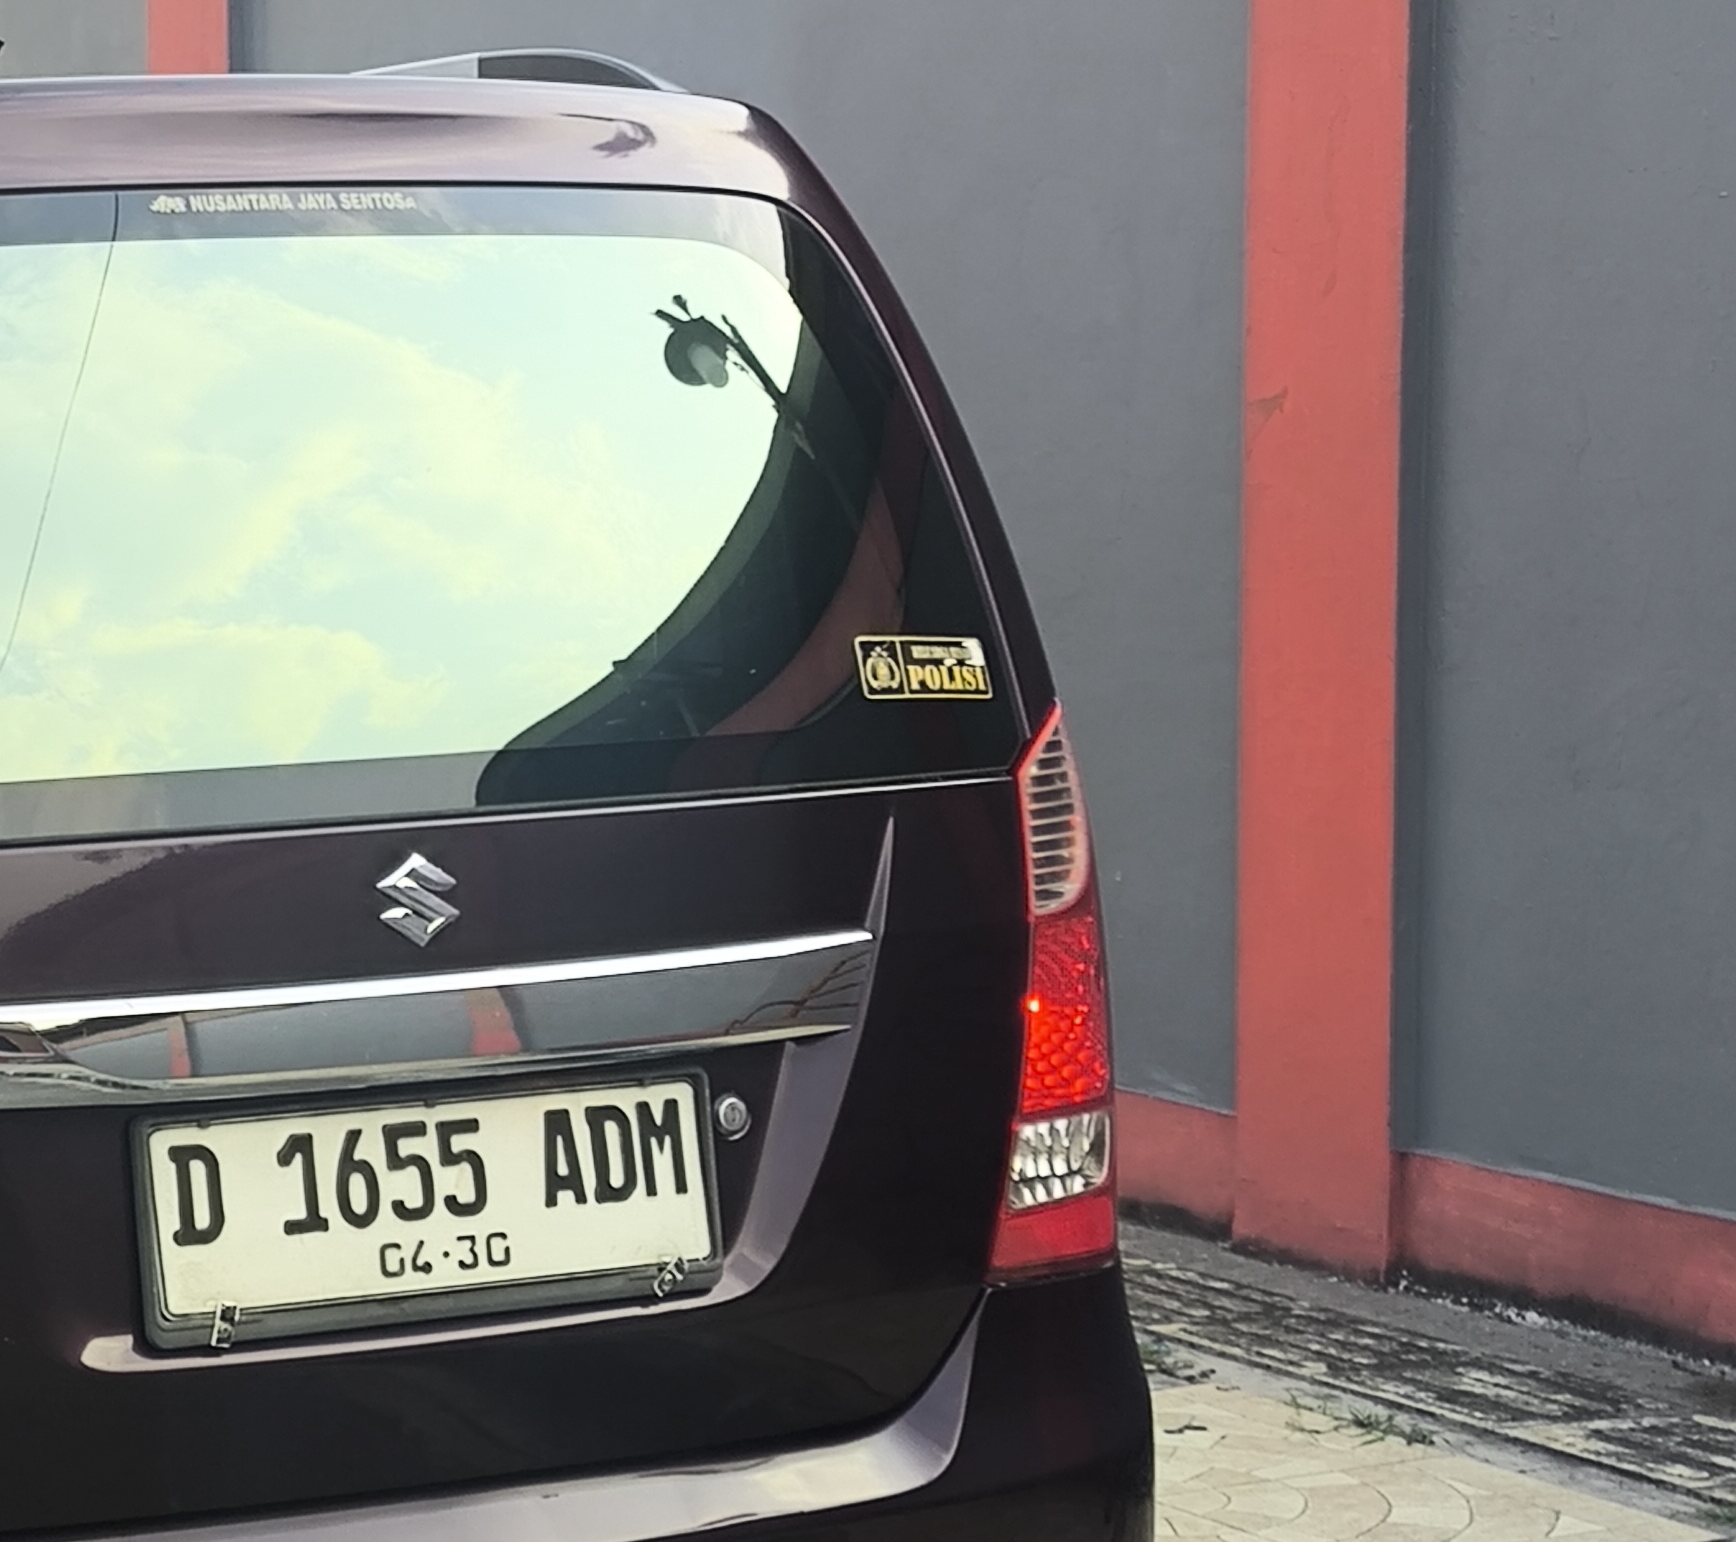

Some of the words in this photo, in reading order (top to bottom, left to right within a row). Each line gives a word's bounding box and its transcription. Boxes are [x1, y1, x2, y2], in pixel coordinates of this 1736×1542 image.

[188, 193, 294, 212] NUSANTARA
[297, 193, 338, 210] JAYA
[906, 664, 987, 691] POLISI
[167, 1144, 226, 1247] D
[276, 1117, 489, 1236] 1655
[543, 1097, 690, 1209] ADM
